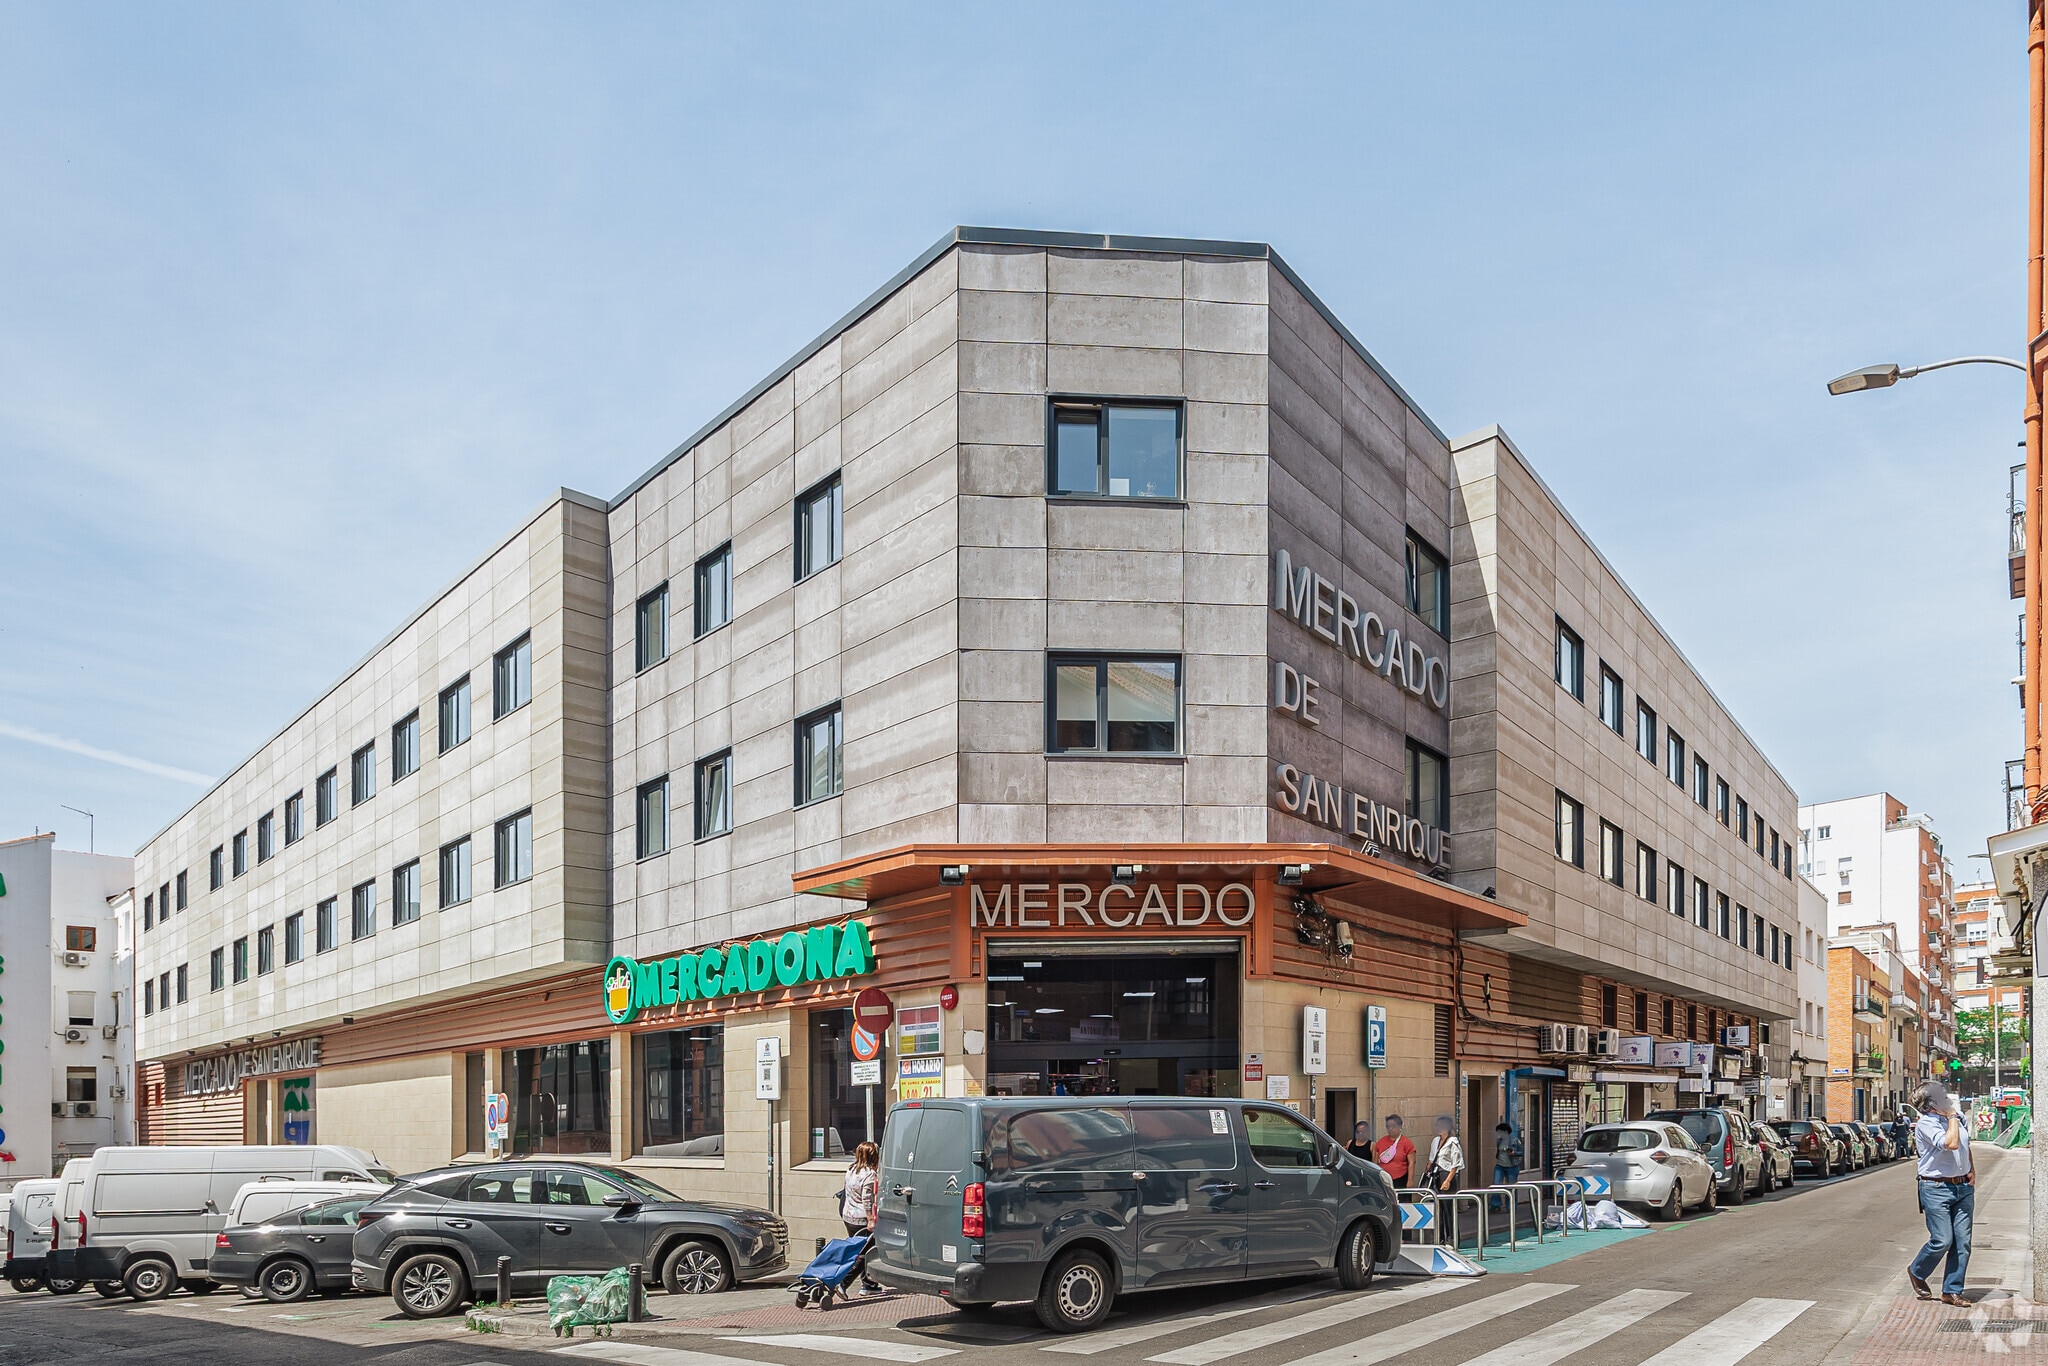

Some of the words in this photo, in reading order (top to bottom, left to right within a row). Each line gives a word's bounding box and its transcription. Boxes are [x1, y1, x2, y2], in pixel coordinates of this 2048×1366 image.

[1275, 549, 1449, 711] MERCADO
[1275, 661, 1320, 726] DE
[1276, 763, 1342, 829] SAN
[1350, 792, 1450, 869] ENRIQUE
[970, 883, 1256, 927] MERCADO
[635, 919, 875, 1009] MERCADONA
[184, 1054, 237, 1096] MERCADO
[239, 1052, 250, 1077] DE
[251, 1048, 271, 1075] SAN
[272, 1037, 322, 1073] ENRIQUE
[912, 1059, 941, 1074] HORARIO
[1371, 1023, 1380, 1052] P
